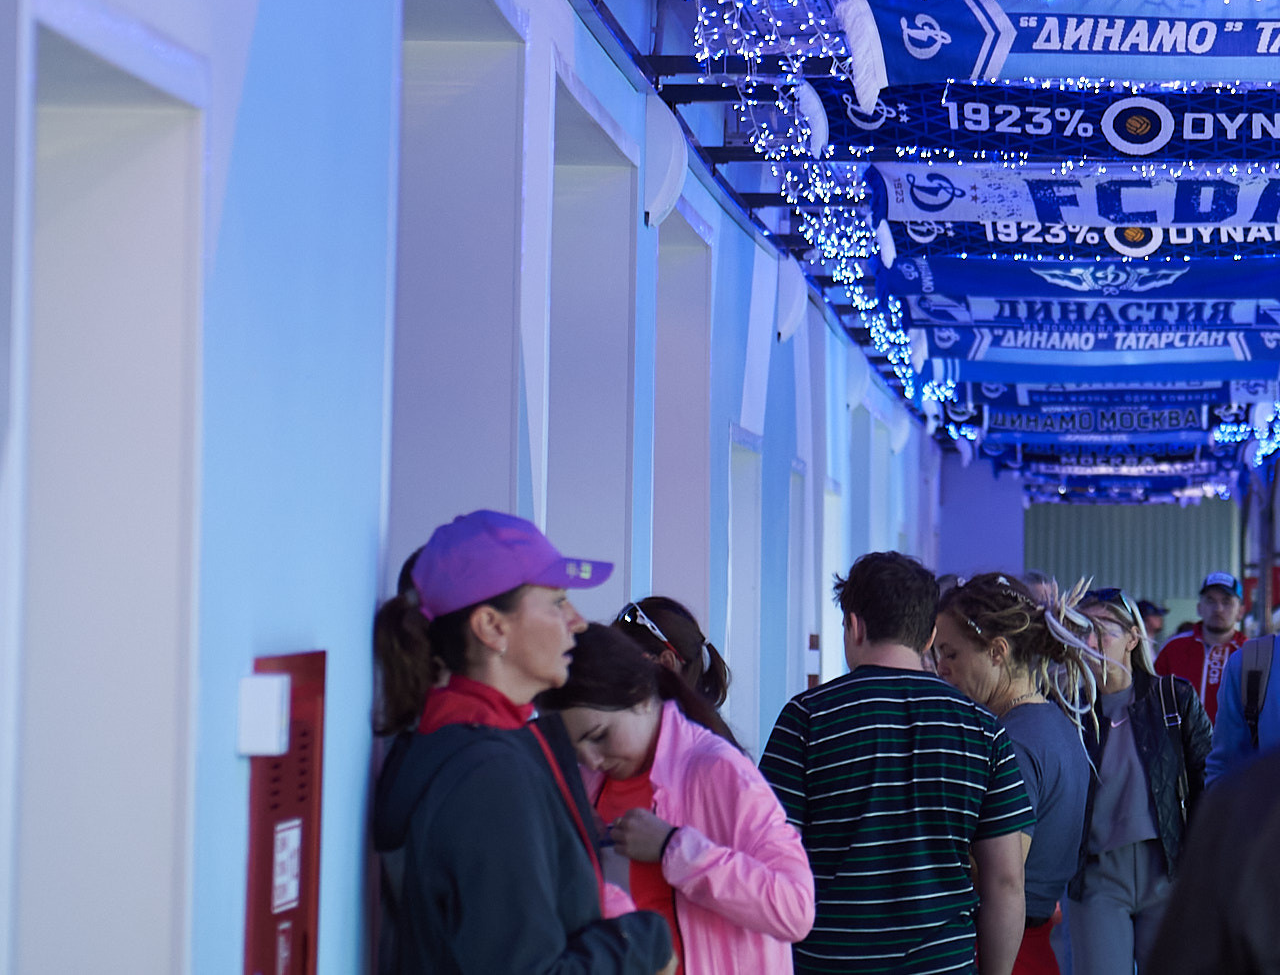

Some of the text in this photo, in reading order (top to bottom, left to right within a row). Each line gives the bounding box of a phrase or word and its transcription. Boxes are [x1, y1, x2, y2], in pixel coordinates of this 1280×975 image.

[942, 101, 1094, 138] 1923%
[979, 221, 1099, 244] 1923%
[994, 300, 1235, 324] ДИНАСТИЯ
[1114, 330, 1225, 351] ТАТАРСТАН
[992, 408, 1200, 433] ДИНАМО МОСКВА
